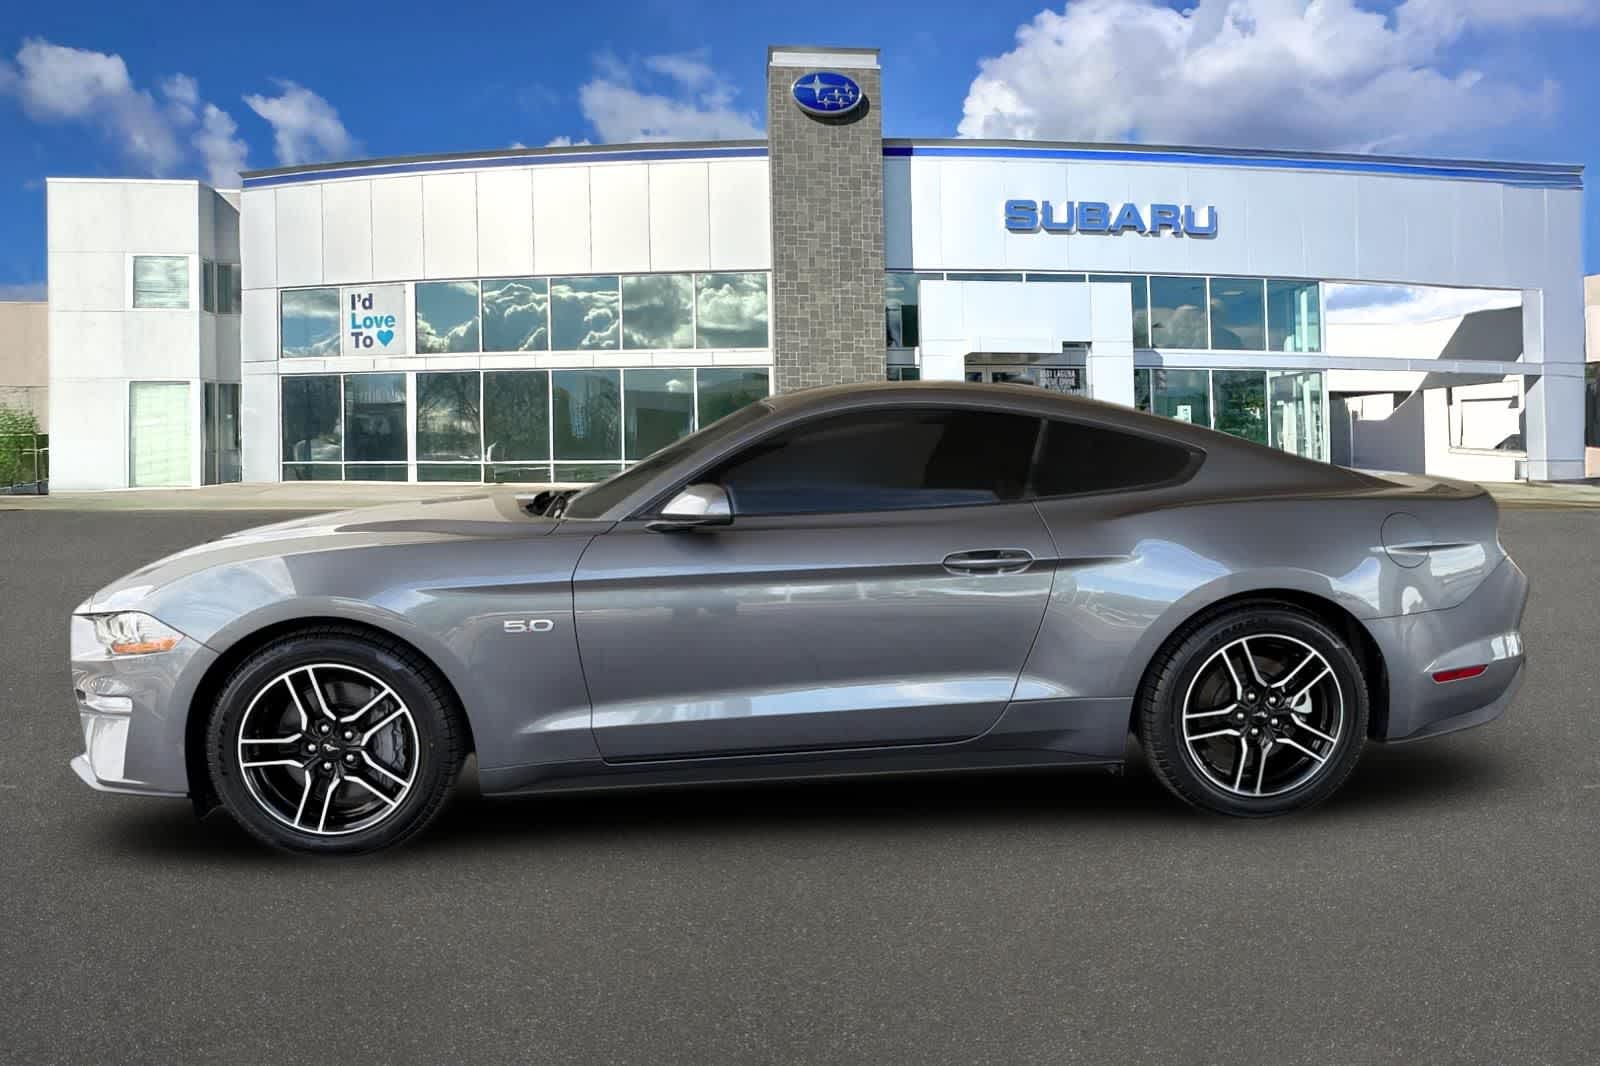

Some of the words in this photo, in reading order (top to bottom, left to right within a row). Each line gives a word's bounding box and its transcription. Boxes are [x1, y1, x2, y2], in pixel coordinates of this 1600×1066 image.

[1005, 199, 1217, 236] SUBARU
[351, 293, 373, 310] I'd
[351, 313, 396, 330] Love
[351, 331, 374, 349] To
